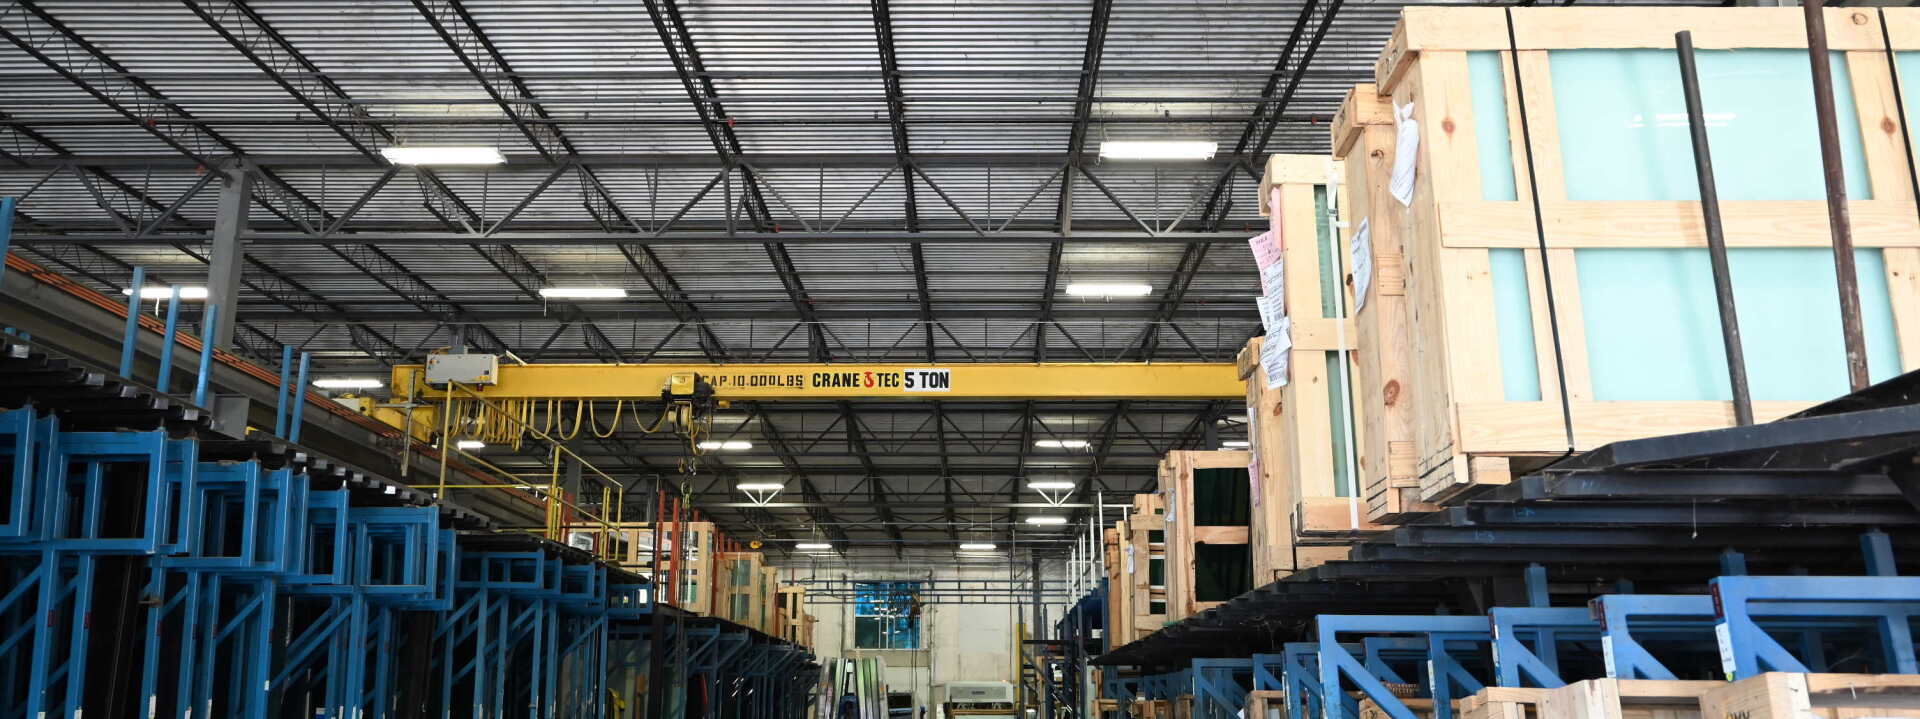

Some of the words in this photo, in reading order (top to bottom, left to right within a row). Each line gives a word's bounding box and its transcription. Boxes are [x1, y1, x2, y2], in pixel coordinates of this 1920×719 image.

[812, 372, 861, 388] CRANE
[876, 372, 900, 388] TEC
[904, 371, 915, 389] 5
[919, 371, 950, 389] TON
